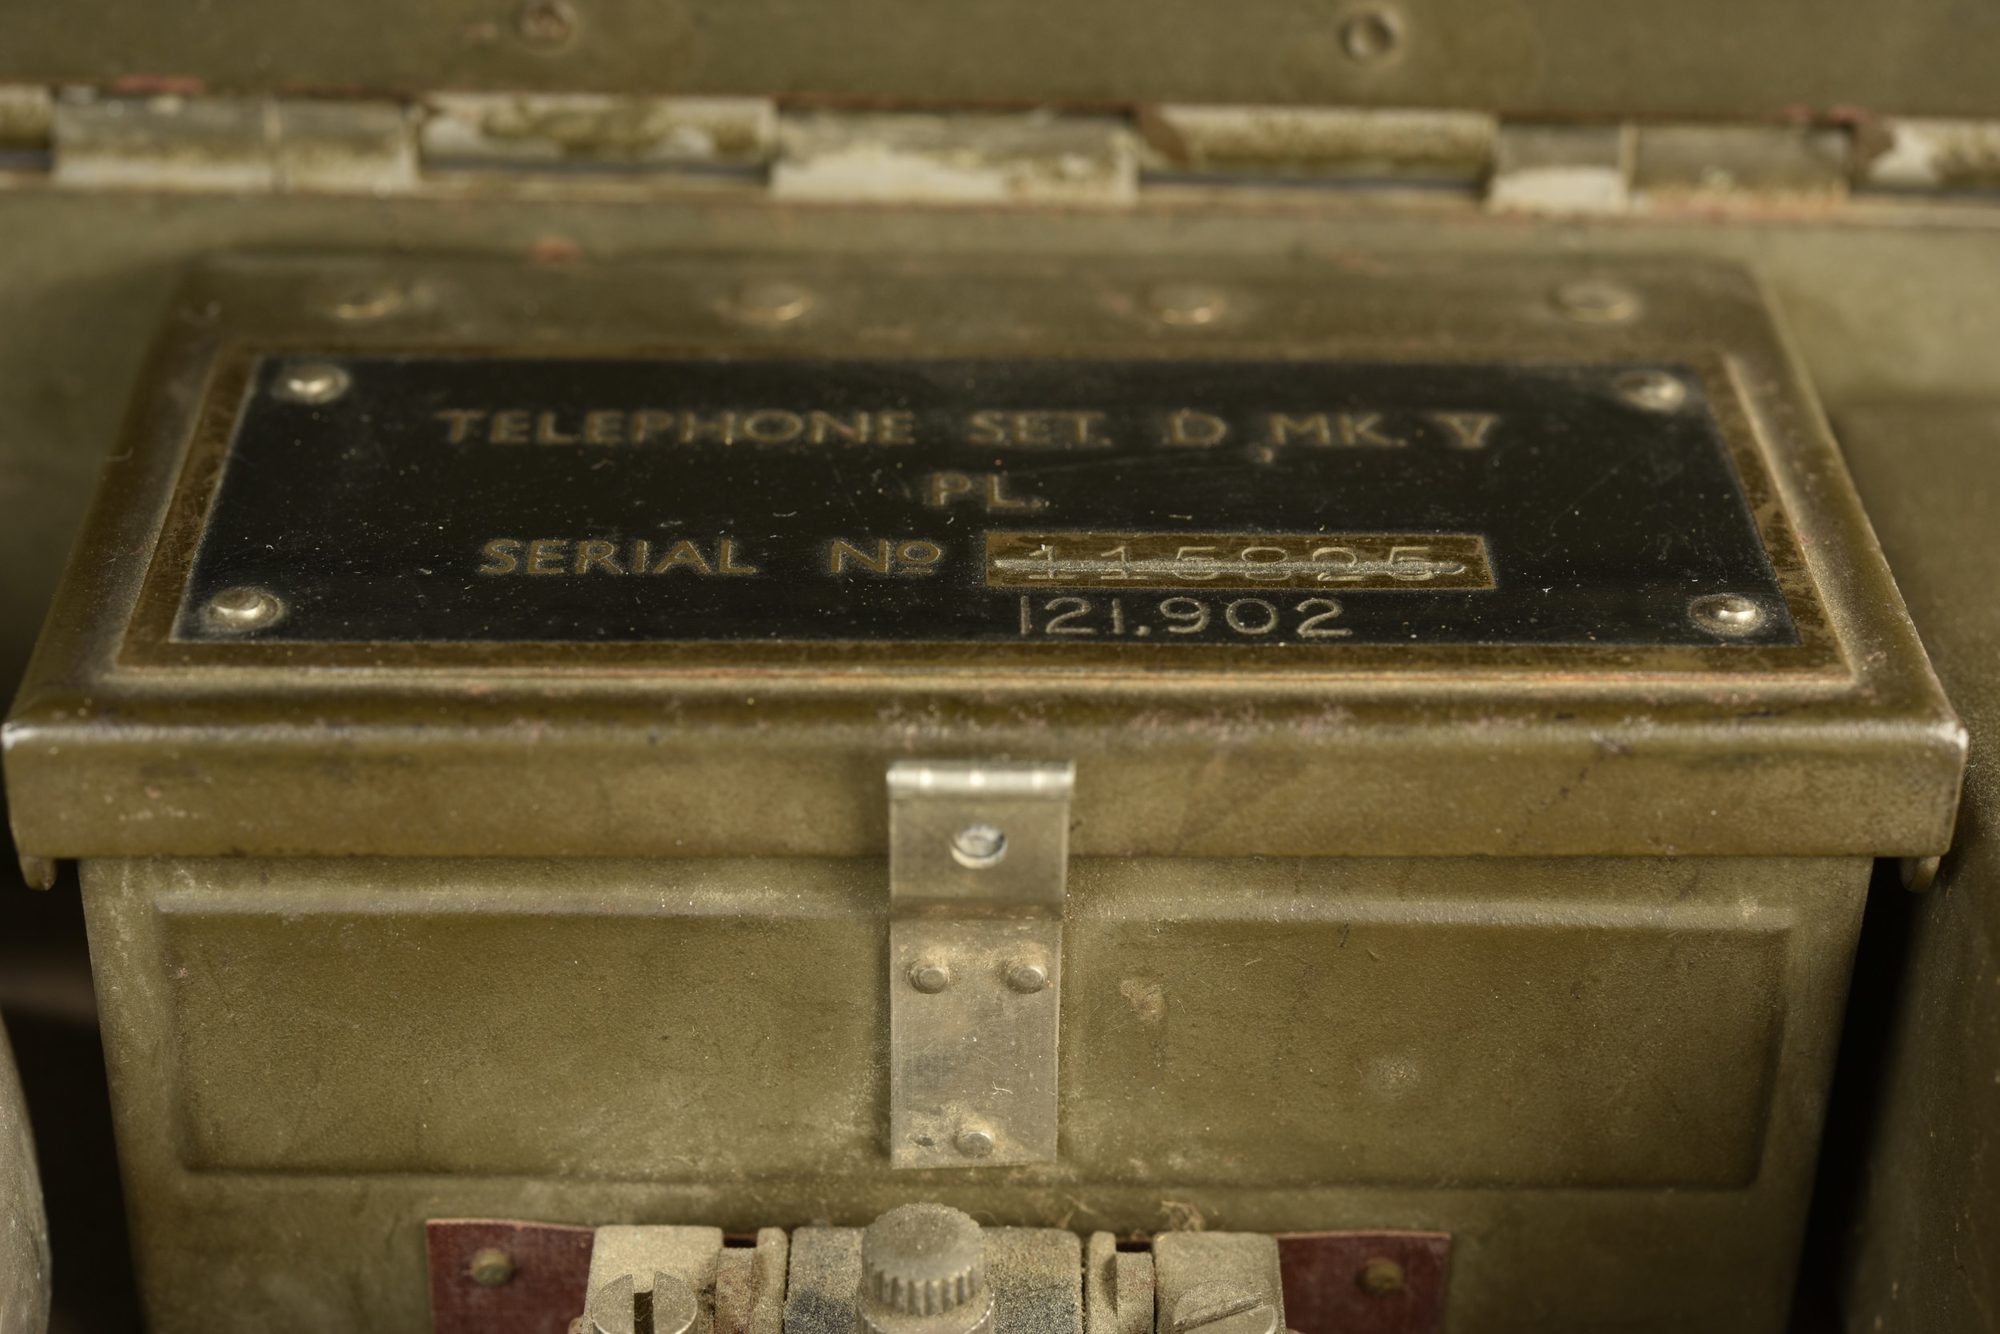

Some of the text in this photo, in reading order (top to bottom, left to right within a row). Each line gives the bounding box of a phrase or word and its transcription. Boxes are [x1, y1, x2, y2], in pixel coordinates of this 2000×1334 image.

[436, 409, 916, 446] TELEPHONE
[480, 539, 759, 576] SERIAL
[1018, 595, 1354, 638] 121.902
